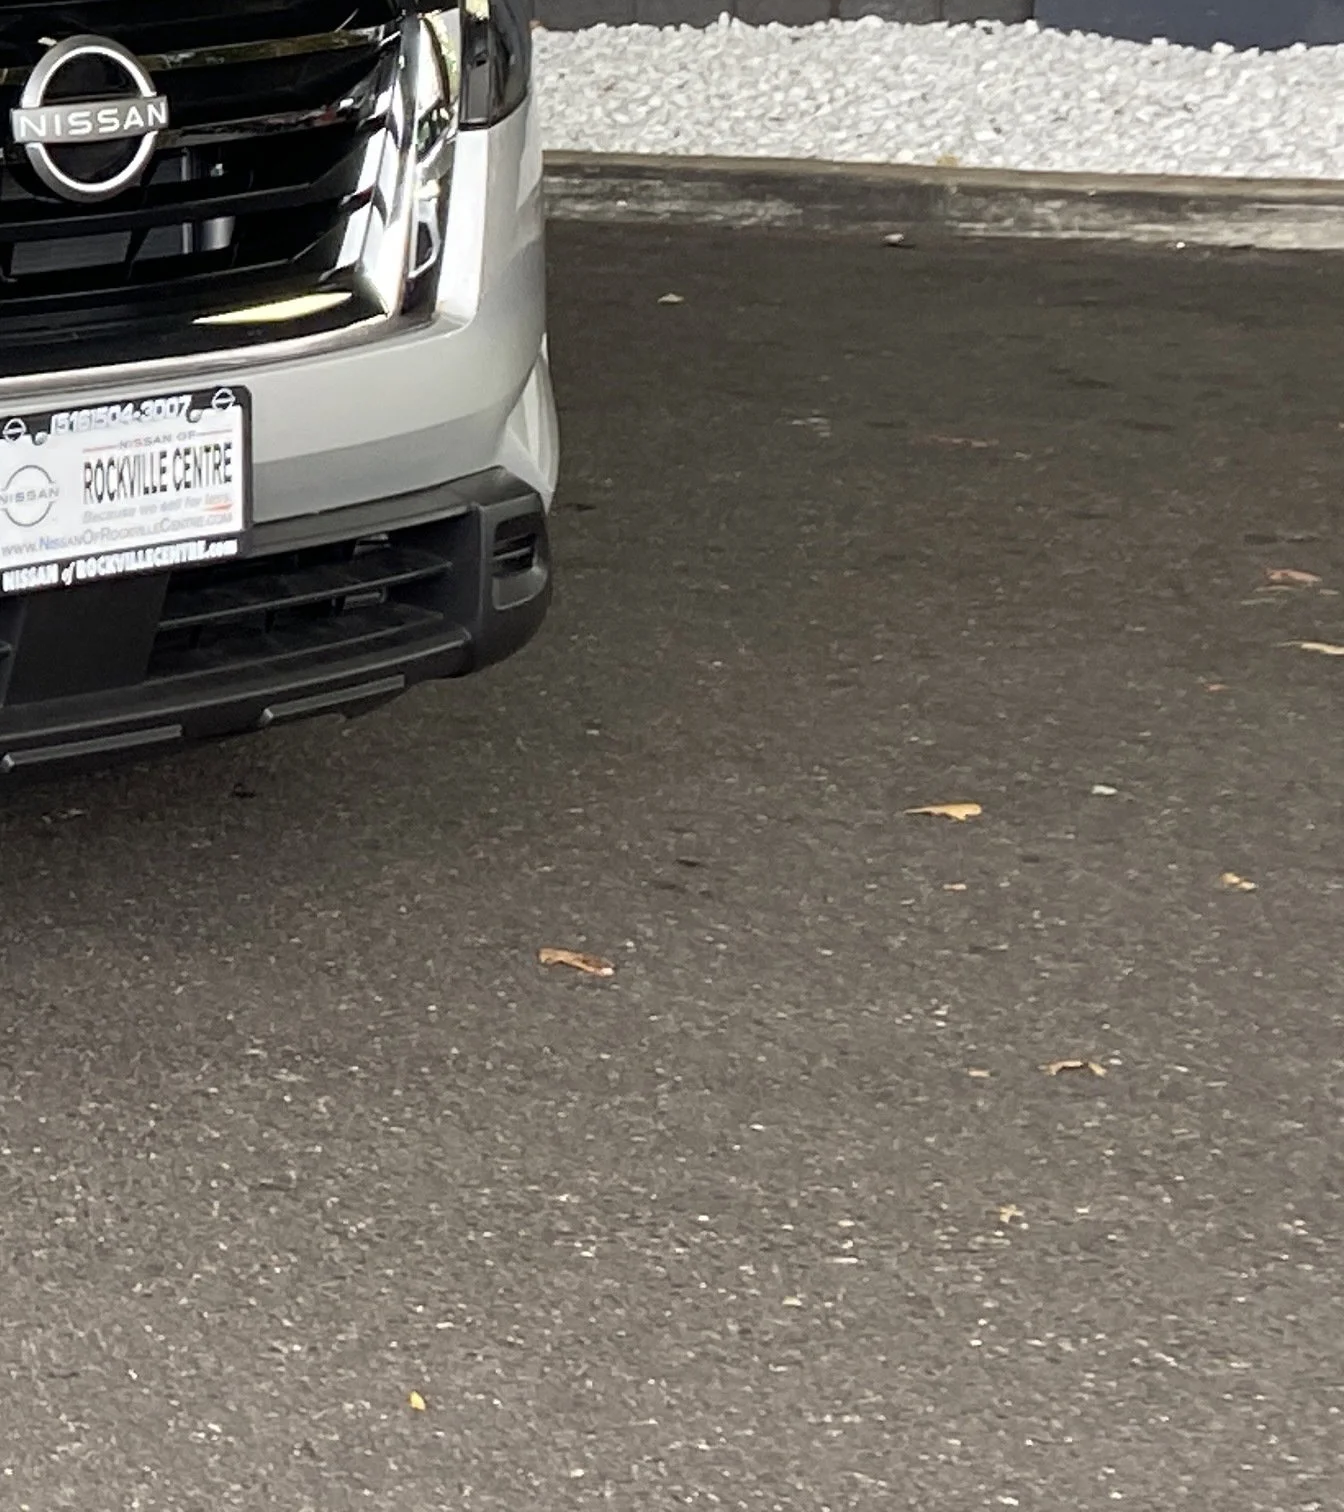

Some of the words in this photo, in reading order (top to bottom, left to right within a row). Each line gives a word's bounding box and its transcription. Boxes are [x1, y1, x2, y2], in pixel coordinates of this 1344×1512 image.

[20, 102, 166, 137] NISSAN
[83, 449, 169, 505] ROCKVILLE
[172, 441, 233, 492] CENTRE
[3, 564, 59, 592] NISSAN
